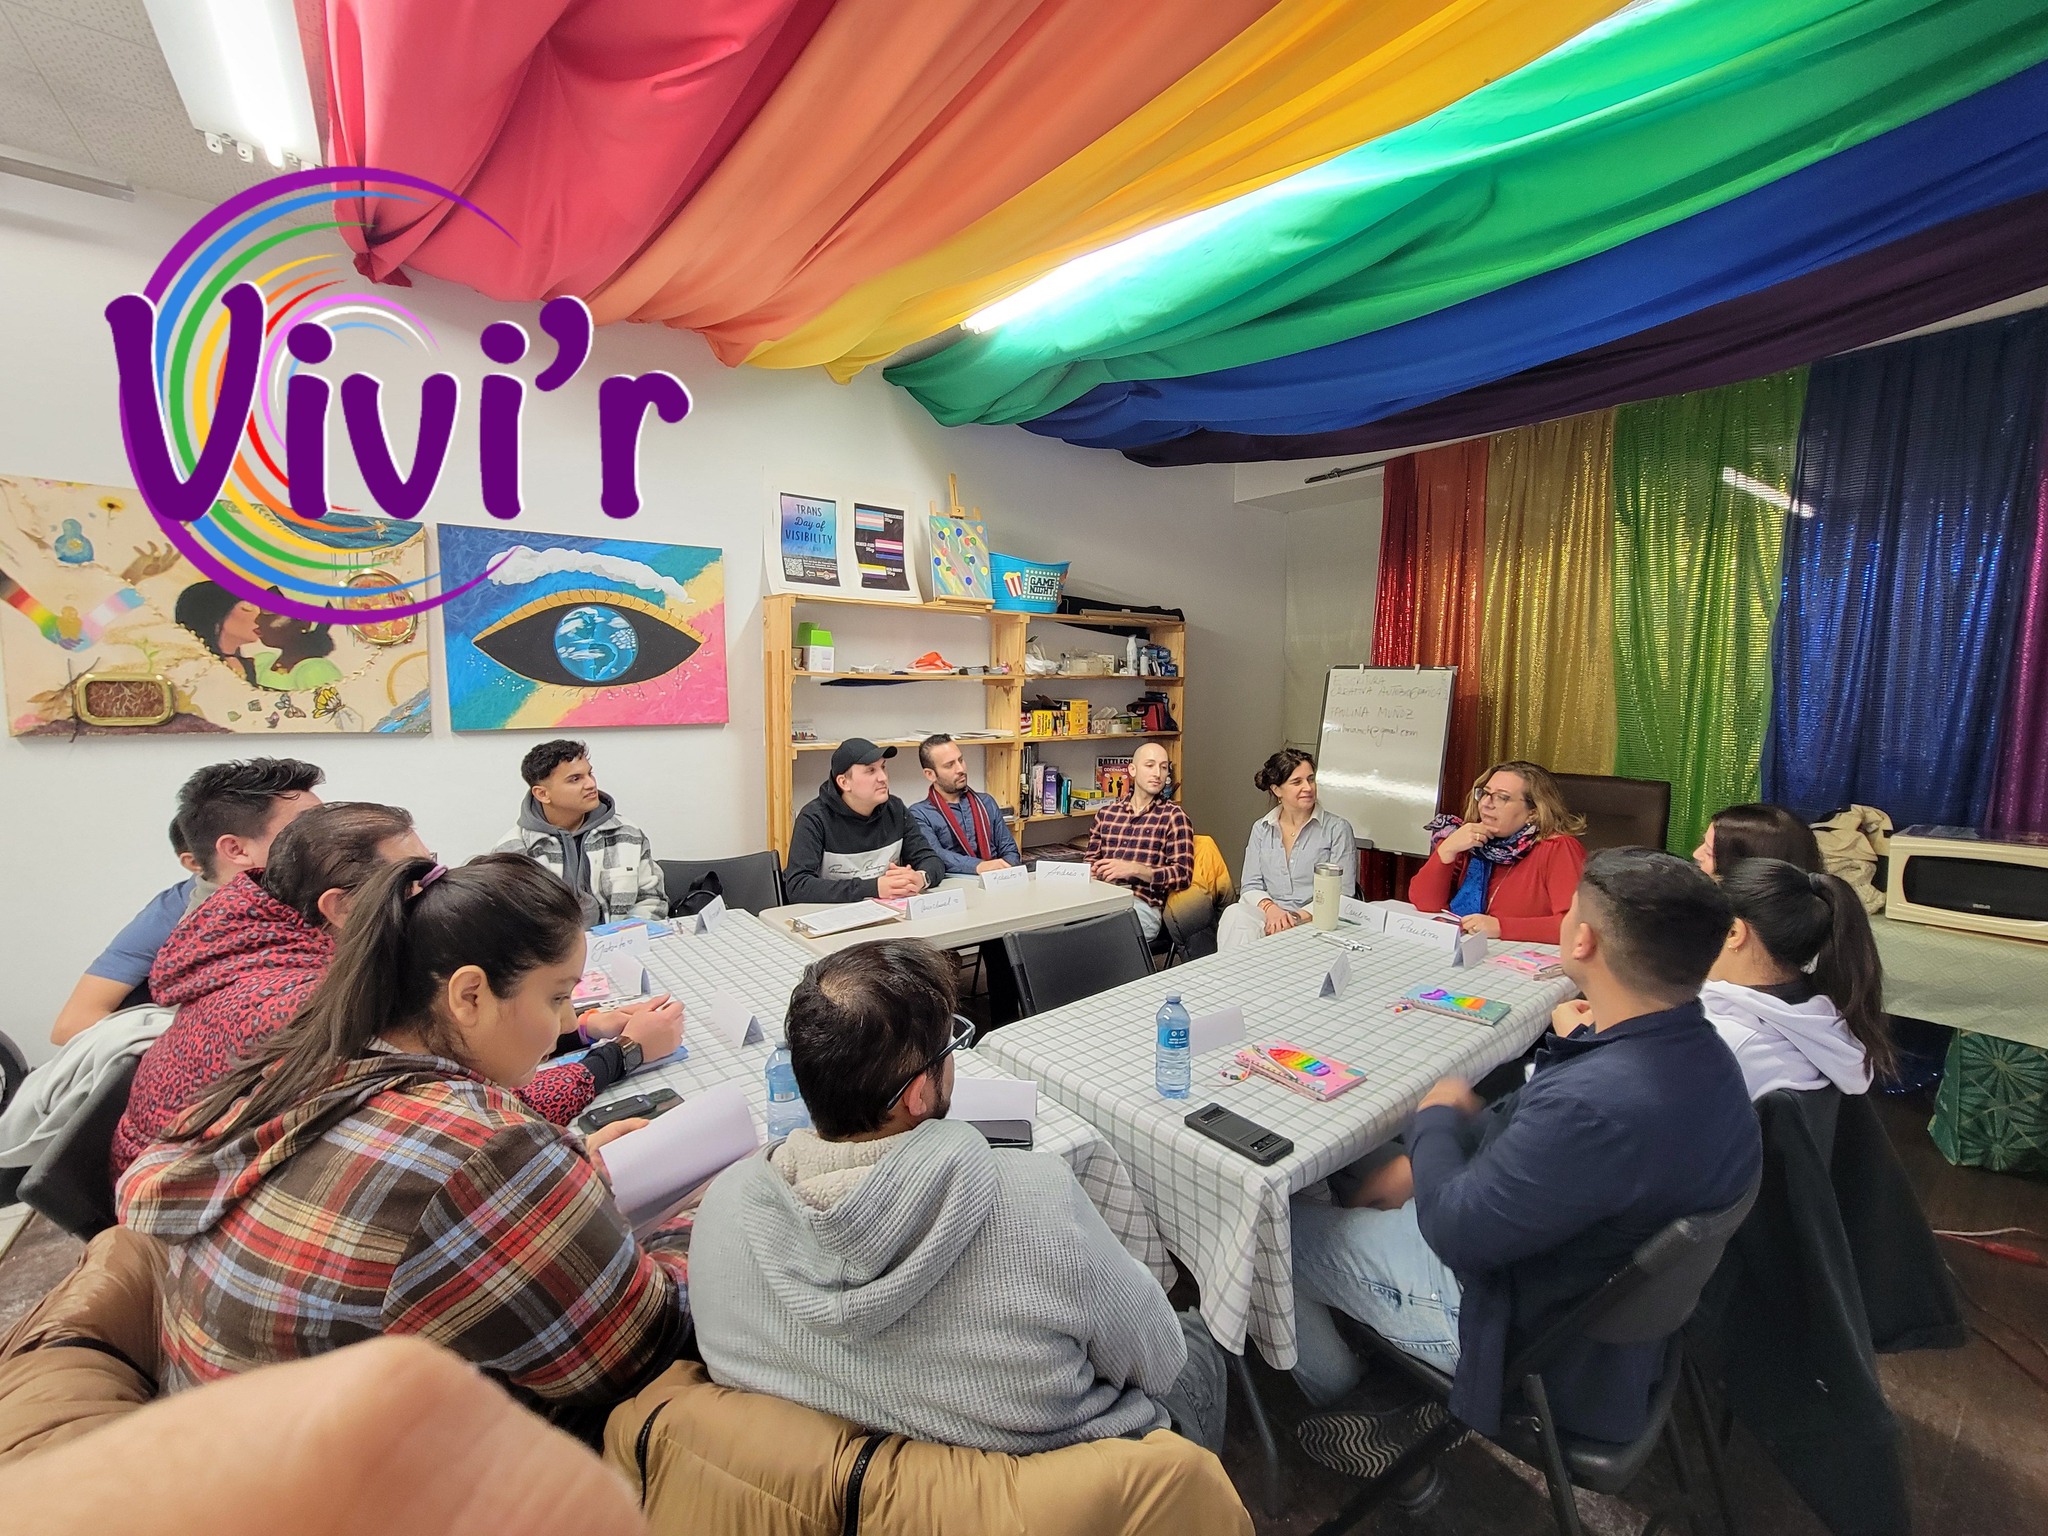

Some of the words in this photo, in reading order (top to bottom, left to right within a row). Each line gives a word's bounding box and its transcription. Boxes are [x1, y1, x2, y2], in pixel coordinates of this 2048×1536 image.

[796, 504, 822, 516] TRANS
[794, 516, 813, 530] Day
[816, 520, 826, 532] of
[785, 529, 833, 545] VISIBILITY
[1030, 576, 1055, 587] GAME
[1029, 585, 1054, 595] NIGHT
[1098, 758, 1133, 767] BATTLESH
[1397, 917, 1440, 941] Paulina
